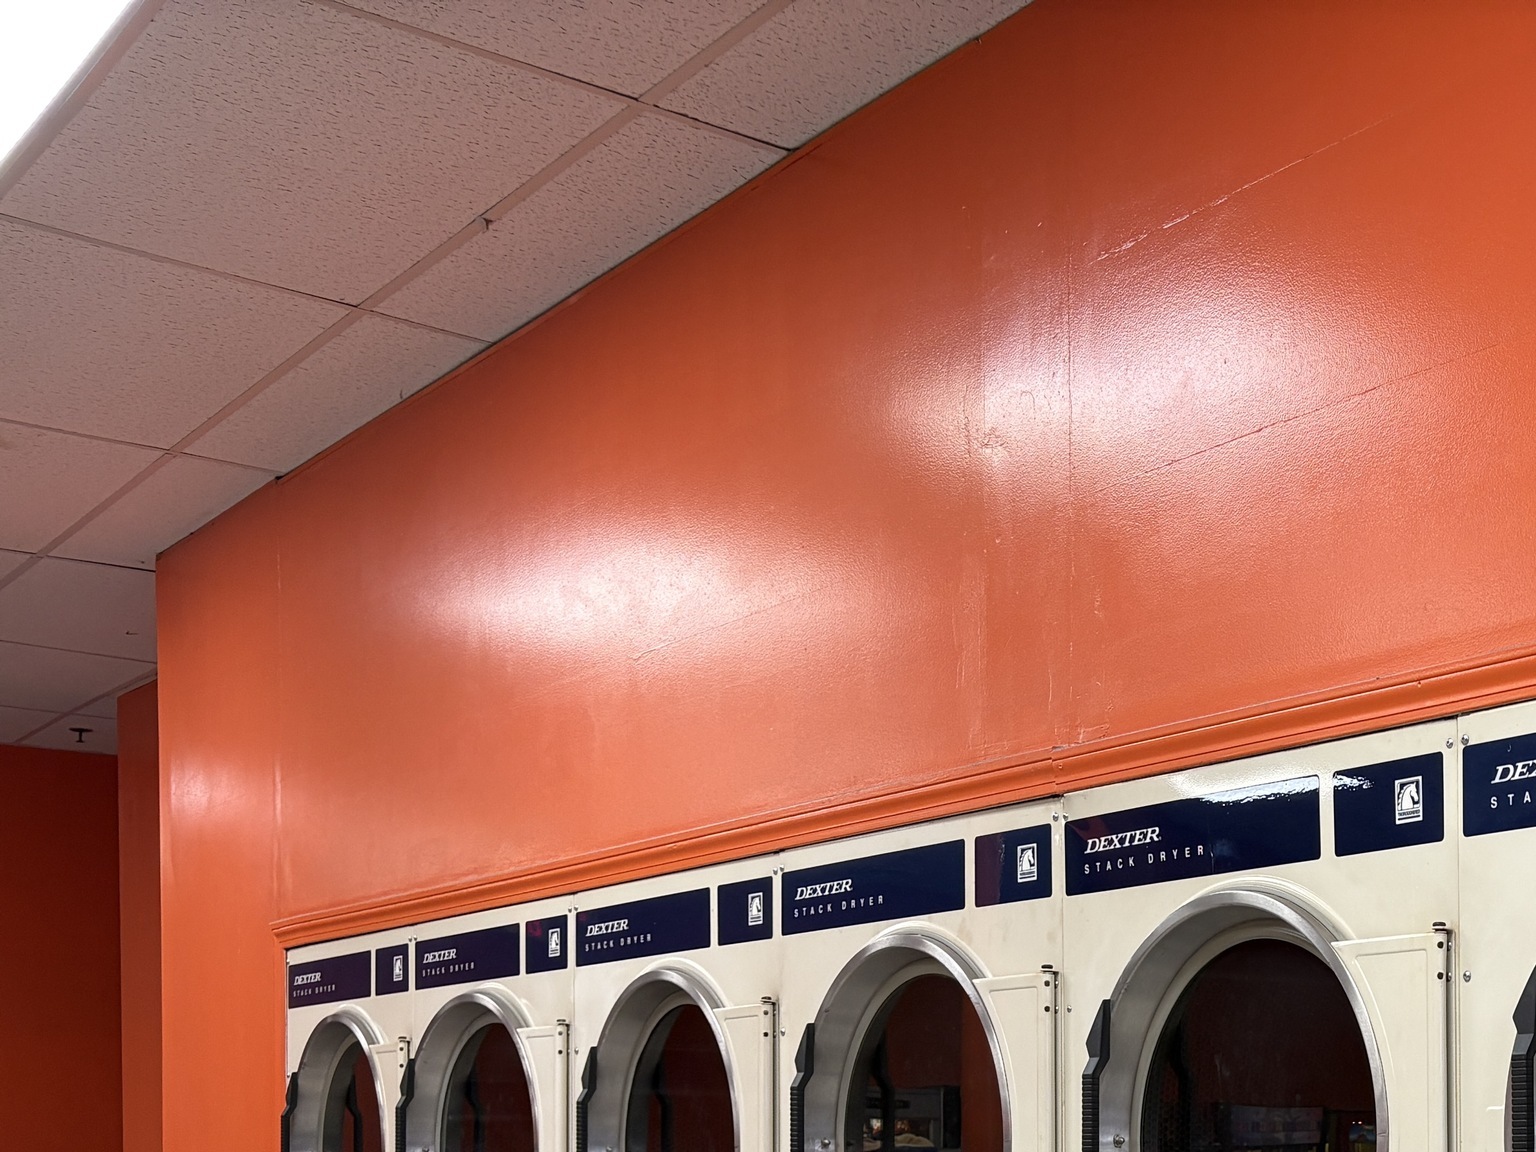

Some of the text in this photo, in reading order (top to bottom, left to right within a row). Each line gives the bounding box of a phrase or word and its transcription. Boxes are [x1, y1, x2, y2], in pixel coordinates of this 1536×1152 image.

[1084, 827, 1160, 854] DEXTER
[1084, 845, 1204, 874] STACK DRYER
[794, 879, 853, 900] DEXTER
[794, 895, 884, 918] STACK DRYER
[585, 919, 629, 936] DEXTER
[422, 948, 457, 963] DEXTER
[585, 940, 614, 952] STACK
